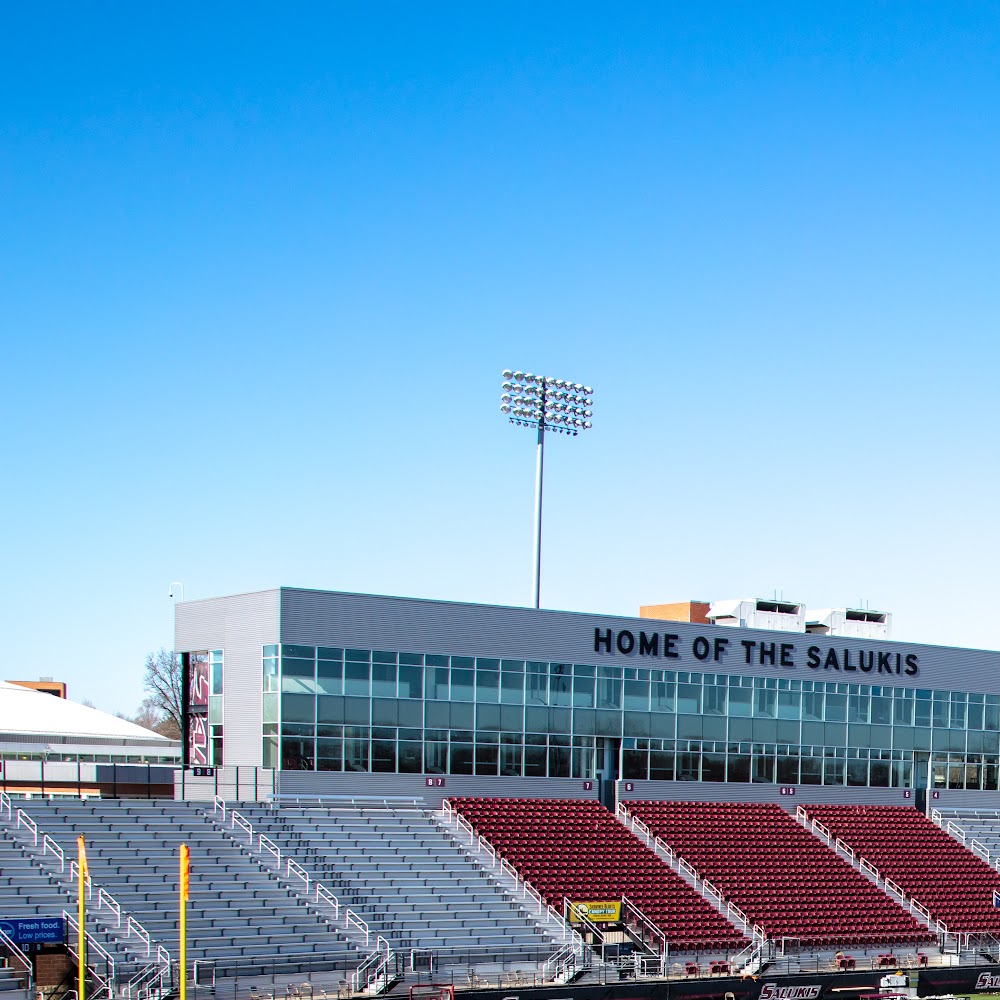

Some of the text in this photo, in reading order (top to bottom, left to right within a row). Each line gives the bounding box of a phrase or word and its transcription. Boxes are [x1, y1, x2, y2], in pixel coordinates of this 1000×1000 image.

[594, 627, 919, 676] HOME OF THE SALUKIS
[18, 921, 60, 930] Fresh food.
[18, 931, 58, 940] Low prices.
[21, 943, 30, 952] 10
[758, 982, 822, 1000] SALUKIS
